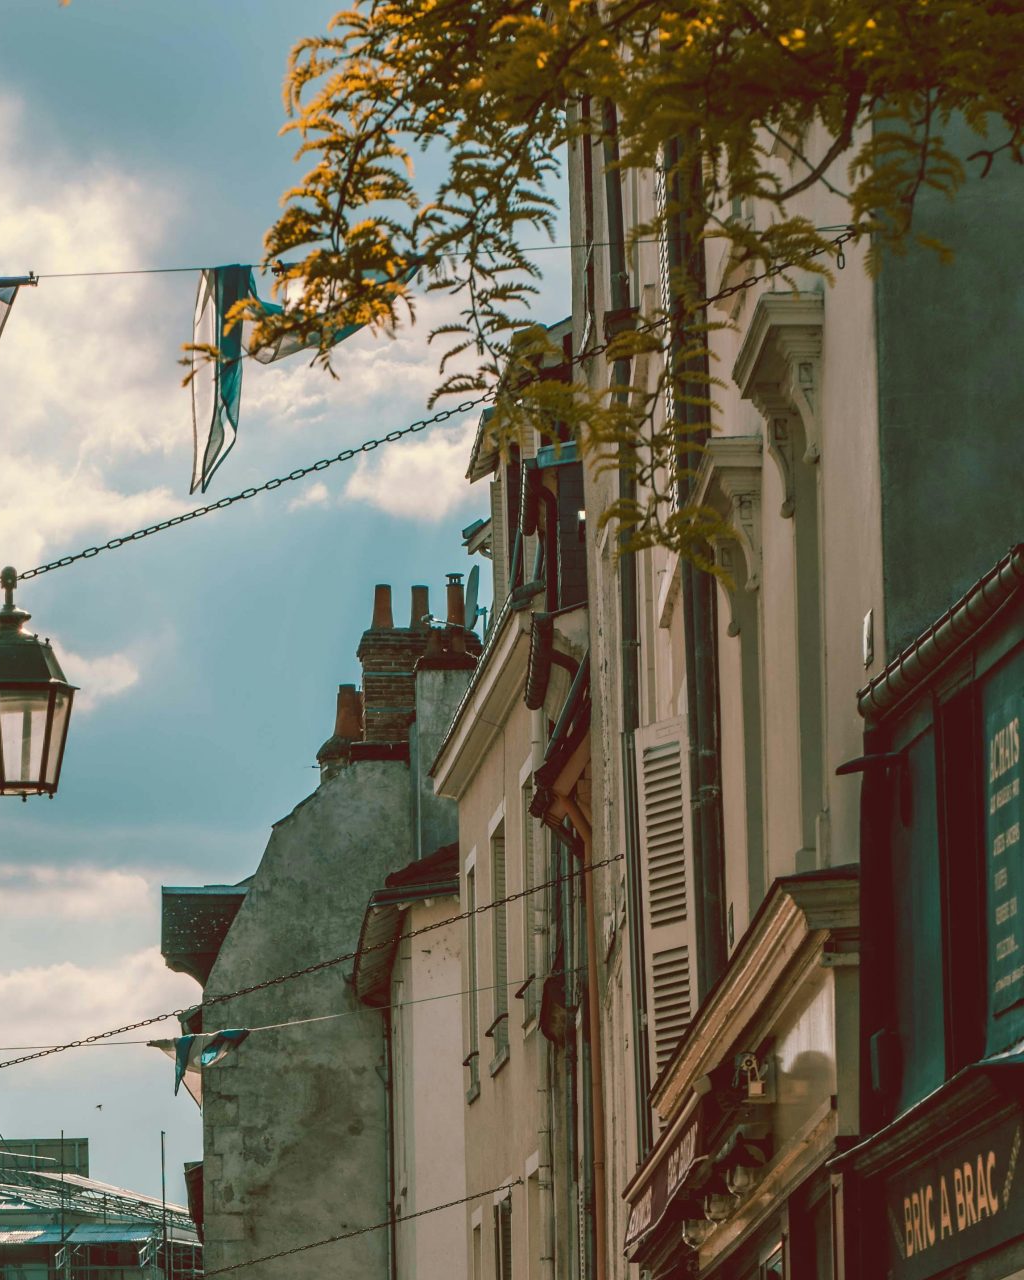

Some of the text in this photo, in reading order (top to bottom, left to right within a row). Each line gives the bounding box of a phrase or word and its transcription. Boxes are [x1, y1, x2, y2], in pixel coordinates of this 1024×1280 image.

[903, 1184, 936, 1258] BRIC
[940, 1175, 953, 1240] A
[954, 1150, 999, 1232] BRAC
